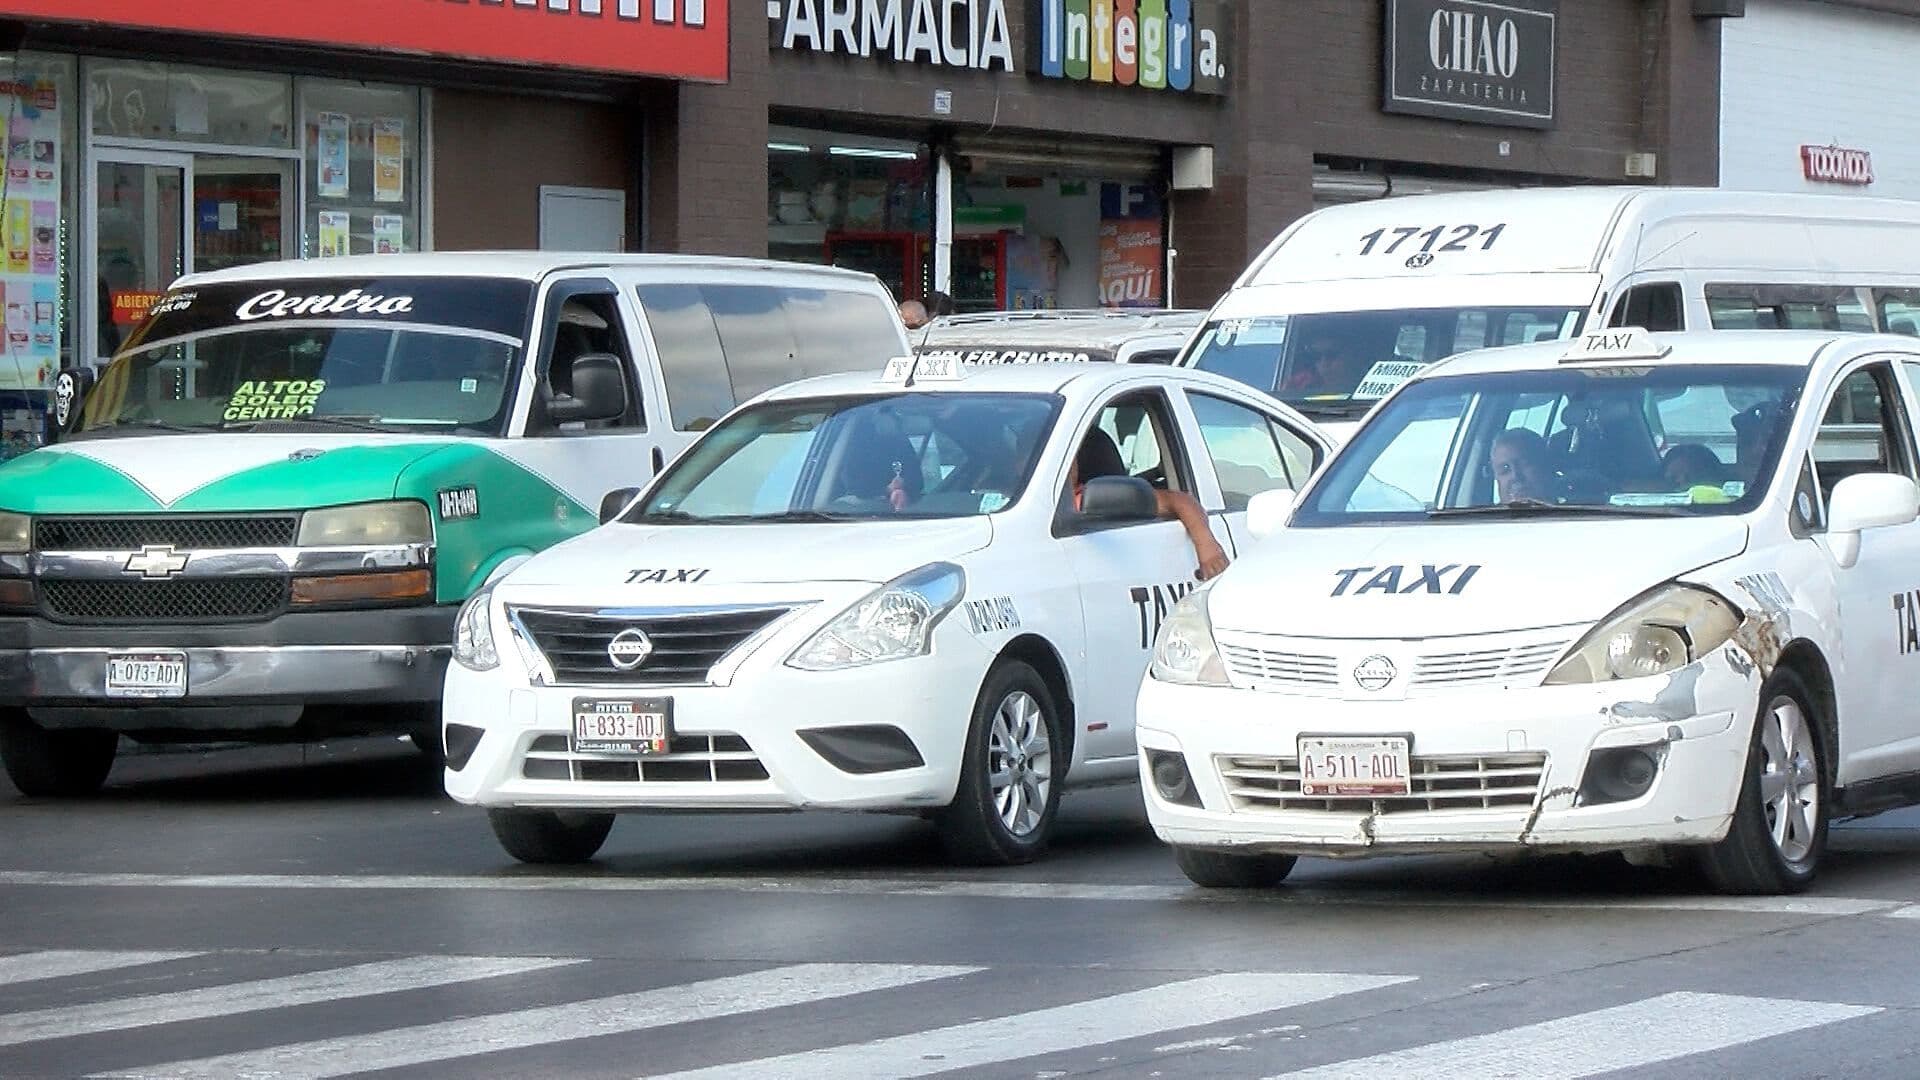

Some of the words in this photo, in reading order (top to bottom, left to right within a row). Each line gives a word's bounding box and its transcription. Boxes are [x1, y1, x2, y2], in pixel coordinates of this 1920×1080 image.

[768, 0, 1014, 72] ARMACIA
[1429, 9, 1518, 78] CHAO
[1420, 75, 1527, 103] ZAPATERIA
[1359, 223, 1506, 256] 17121
[116, 295, 161, 308] ABIERT
[1587, 333, 1633, 350] TAXI
[1373, 363, 1426, 378] MIRAD
[234, 379, 326, 396] ALTOS
[1358, 381, 1400, 396] MIRA
[230, 395, 318, 407] SOLER
[223, 406, 315, 420] CENTRO
[624, 568, 711, 584] TAXI
[1330, 564, 1483, 598] TAXI
[1130, 581, 1194, 650] TA
[1893, 590, 1920, 656] TA
[109, 663, 181, 684] A-073-ADY
[579, 715, 664, 738] A-833-ADJ
